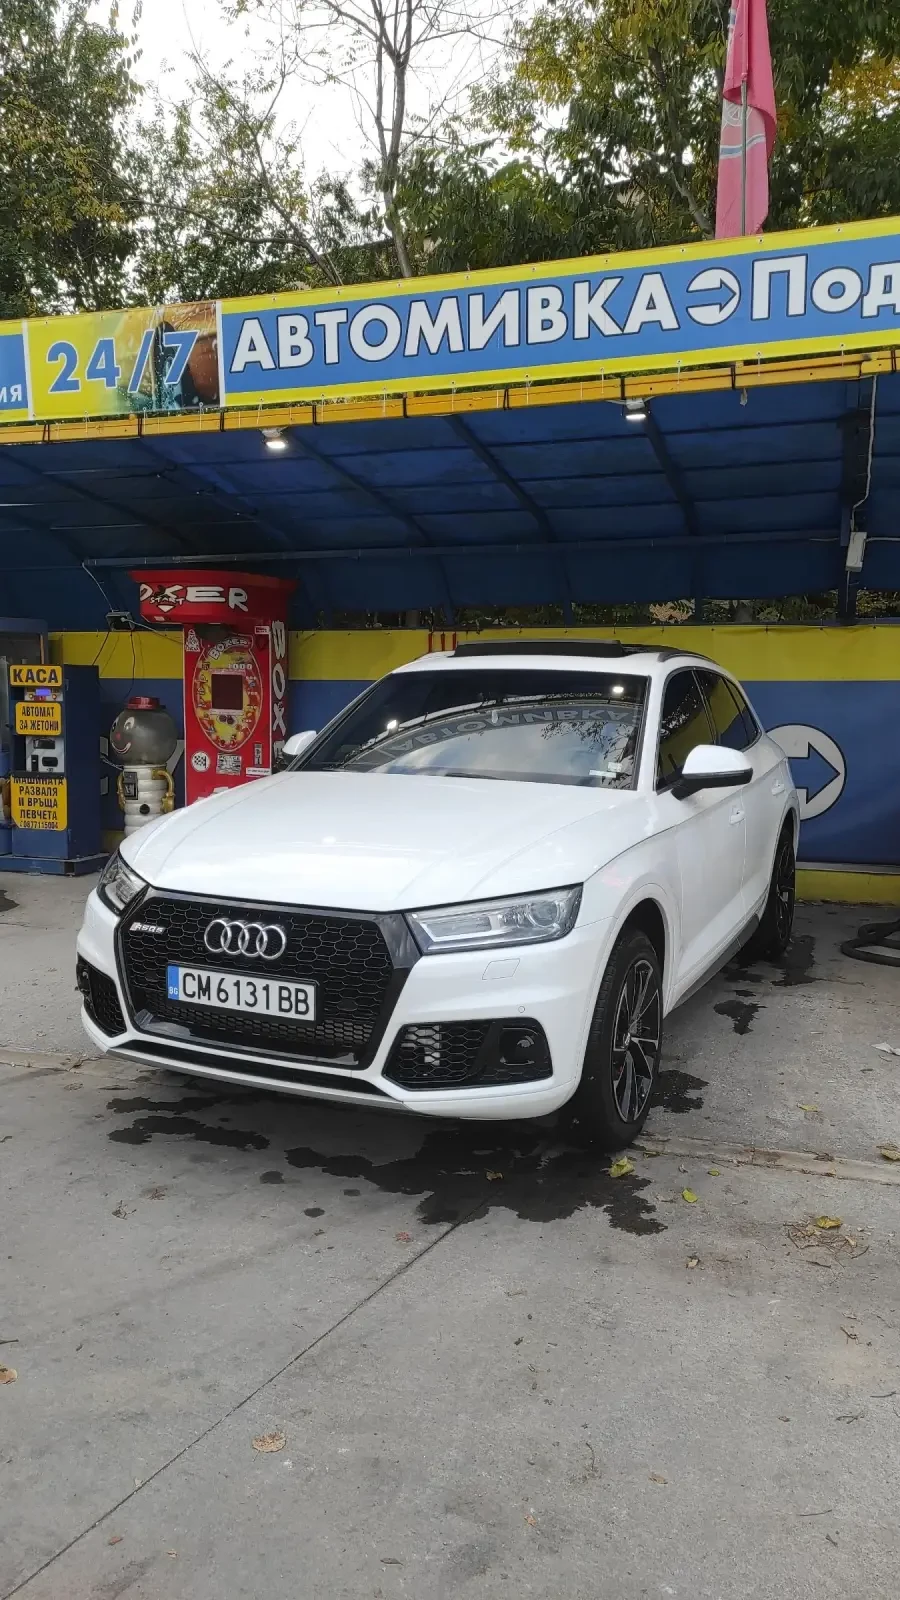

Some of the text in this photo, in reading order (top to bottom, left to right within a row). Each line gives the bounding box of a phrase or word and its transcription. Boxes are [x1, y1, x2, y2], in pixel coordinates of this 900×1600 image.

[229, 271, 681, 374] АВТОМИВКА
[46, 329, 200, 394] 24/7
[12, 668, 59, 683] КАСА
[22, 705, 55, 717] АВТОМАТ
[20, 719, 59, 731] ЗА ЖЕТОНИ
[19, 785, 58, 797] РАЗВАЛЯ
[18, 796, 58, 808] И ВРЪЩА
[20, 809, 57, 820] ЛЕВЧЕТА
[168, 986, 178, 995] BG
